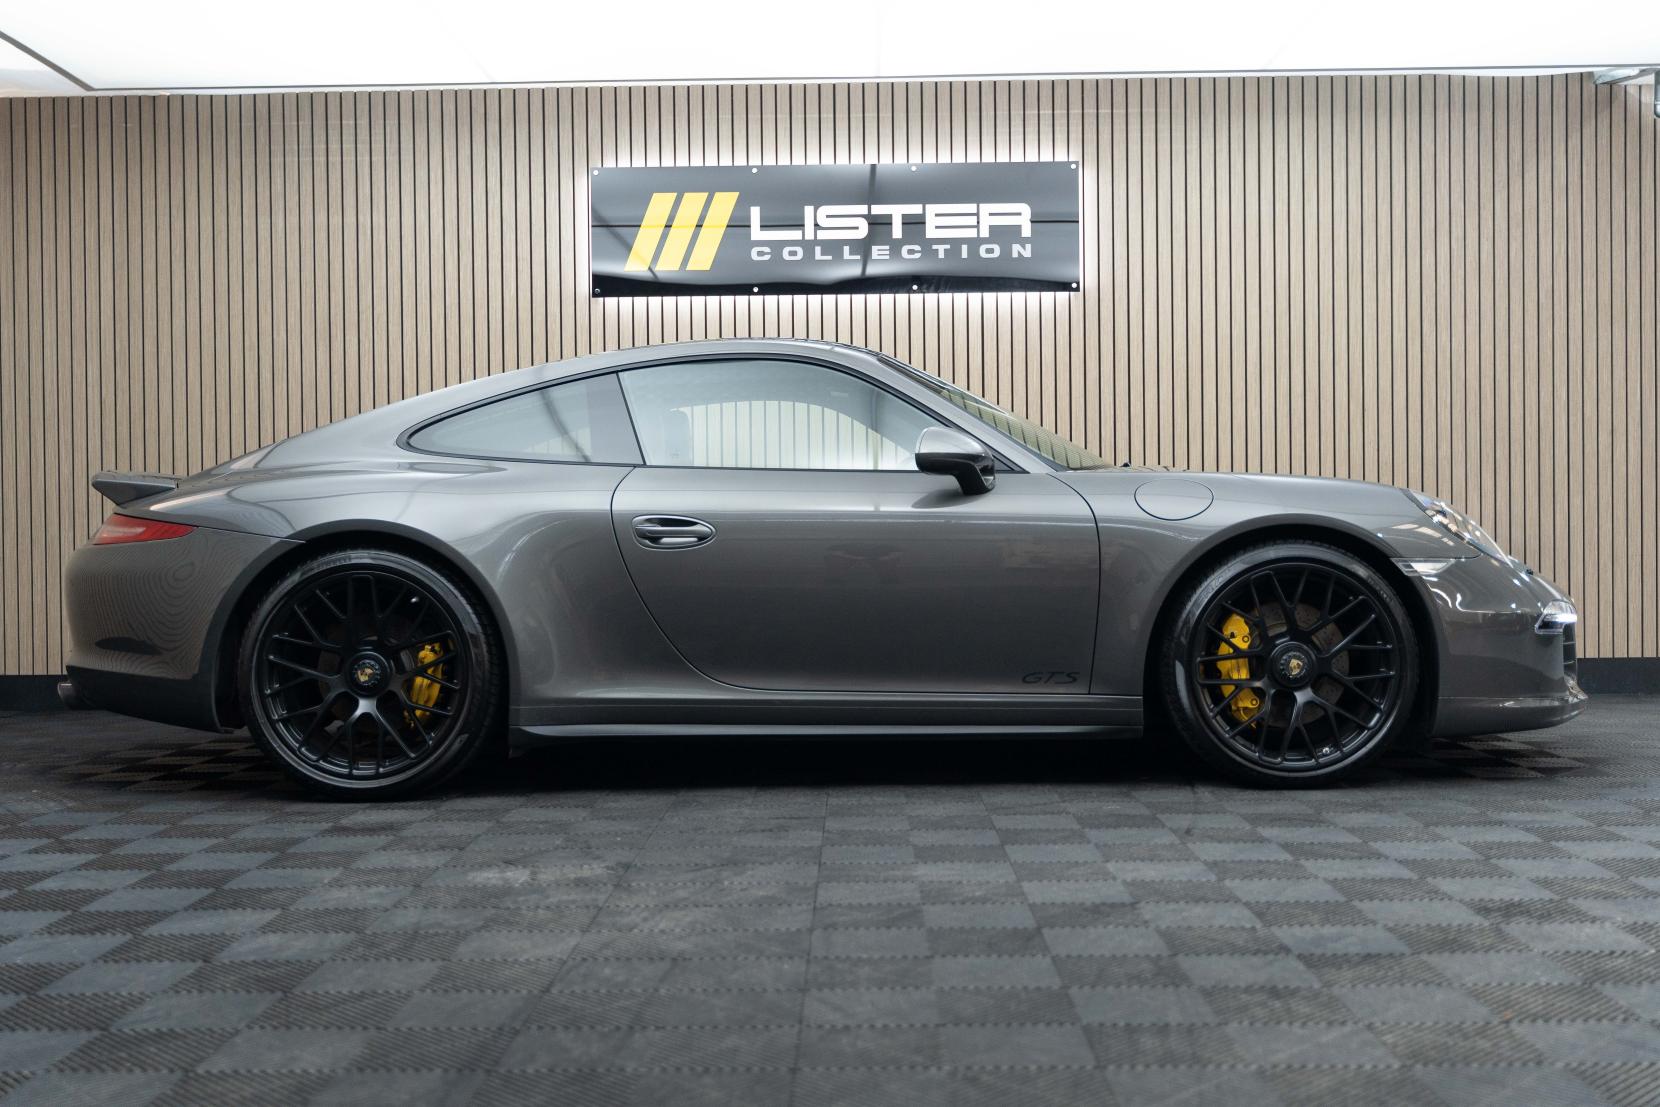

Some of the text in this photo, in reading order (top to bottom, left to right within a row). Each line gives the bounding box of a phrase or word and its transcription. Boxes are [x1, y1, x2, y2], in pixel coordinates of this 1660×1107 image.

[750, 203, 1032, 241] LISTER
[750, 243, 1032, 261] COLLECTION
[1022, 671, 1081, 685] GTS
